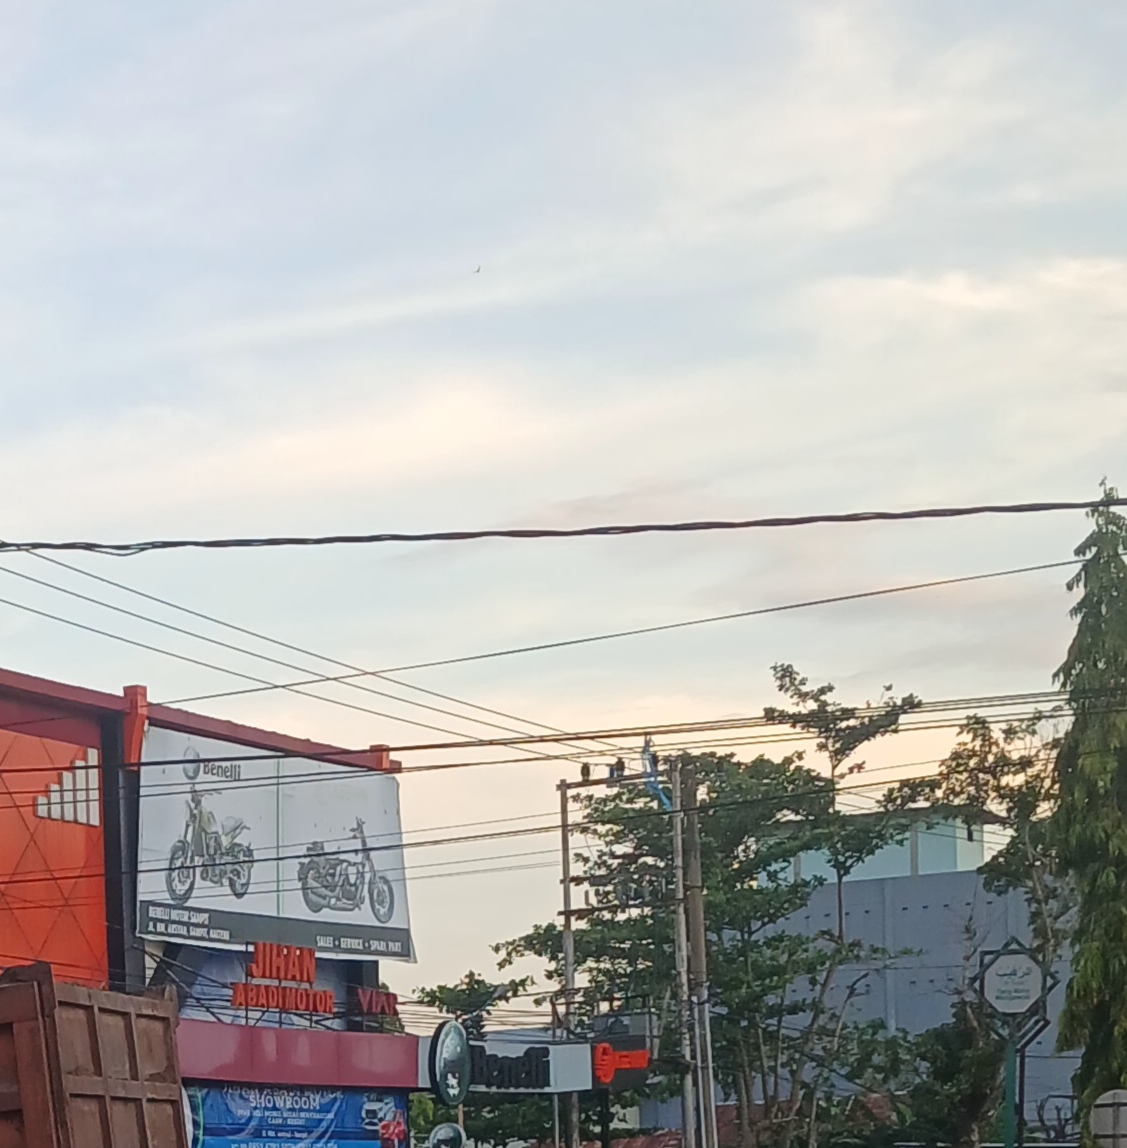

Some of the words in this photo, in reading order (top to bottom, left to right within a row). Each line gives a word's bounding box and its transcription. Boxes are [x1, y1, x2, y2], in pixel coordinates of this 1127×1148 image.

[203, 761, 241, 781] Benelli
[250, 942, 316, 983] JIHAN
[234, 983, 283, 1009] ABADI
[284, 986, 335, 1015] MOTOR
[469, 1045, 551, 1090] Benelli
[249, 1094, 321, 1110] SHOWROOM
